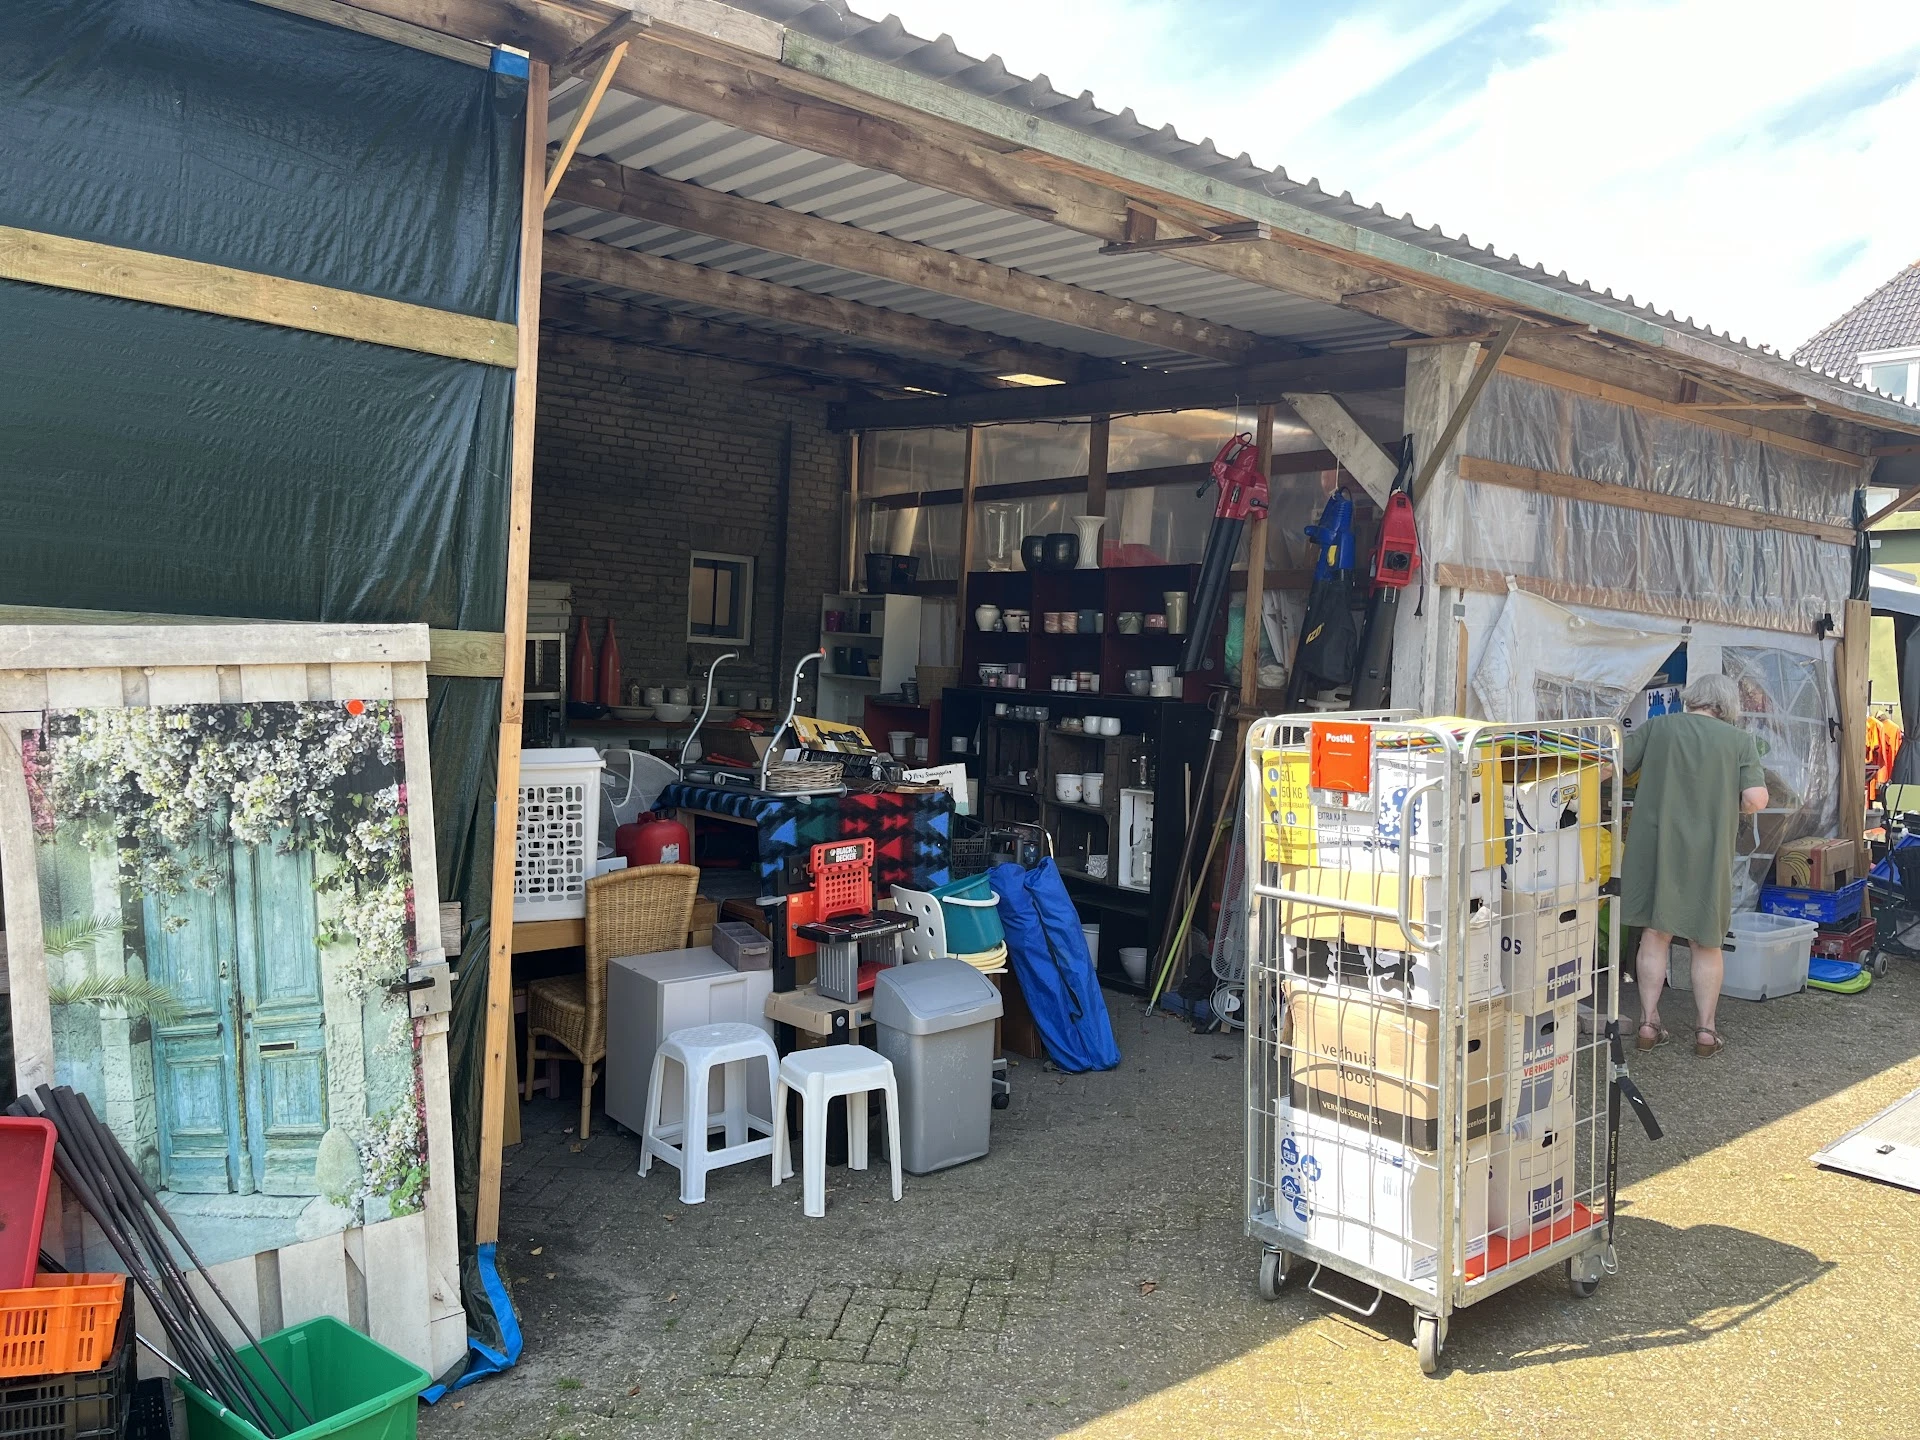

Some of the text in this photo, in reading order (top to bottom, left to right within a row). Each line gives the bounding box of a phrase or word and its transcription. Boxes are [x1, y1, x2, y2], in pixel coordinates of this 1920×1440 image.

[1325, 731, 1356, 744] PostNL
[1280, 770, 1290, 782] 50
[1281, 786, 1303, 799] 50 KG
[1318, 811, 1333, 821] EXTRA
[835, 852, 857, 863] DECKER
[1321, 1043, 1376, 1067] verhuis
